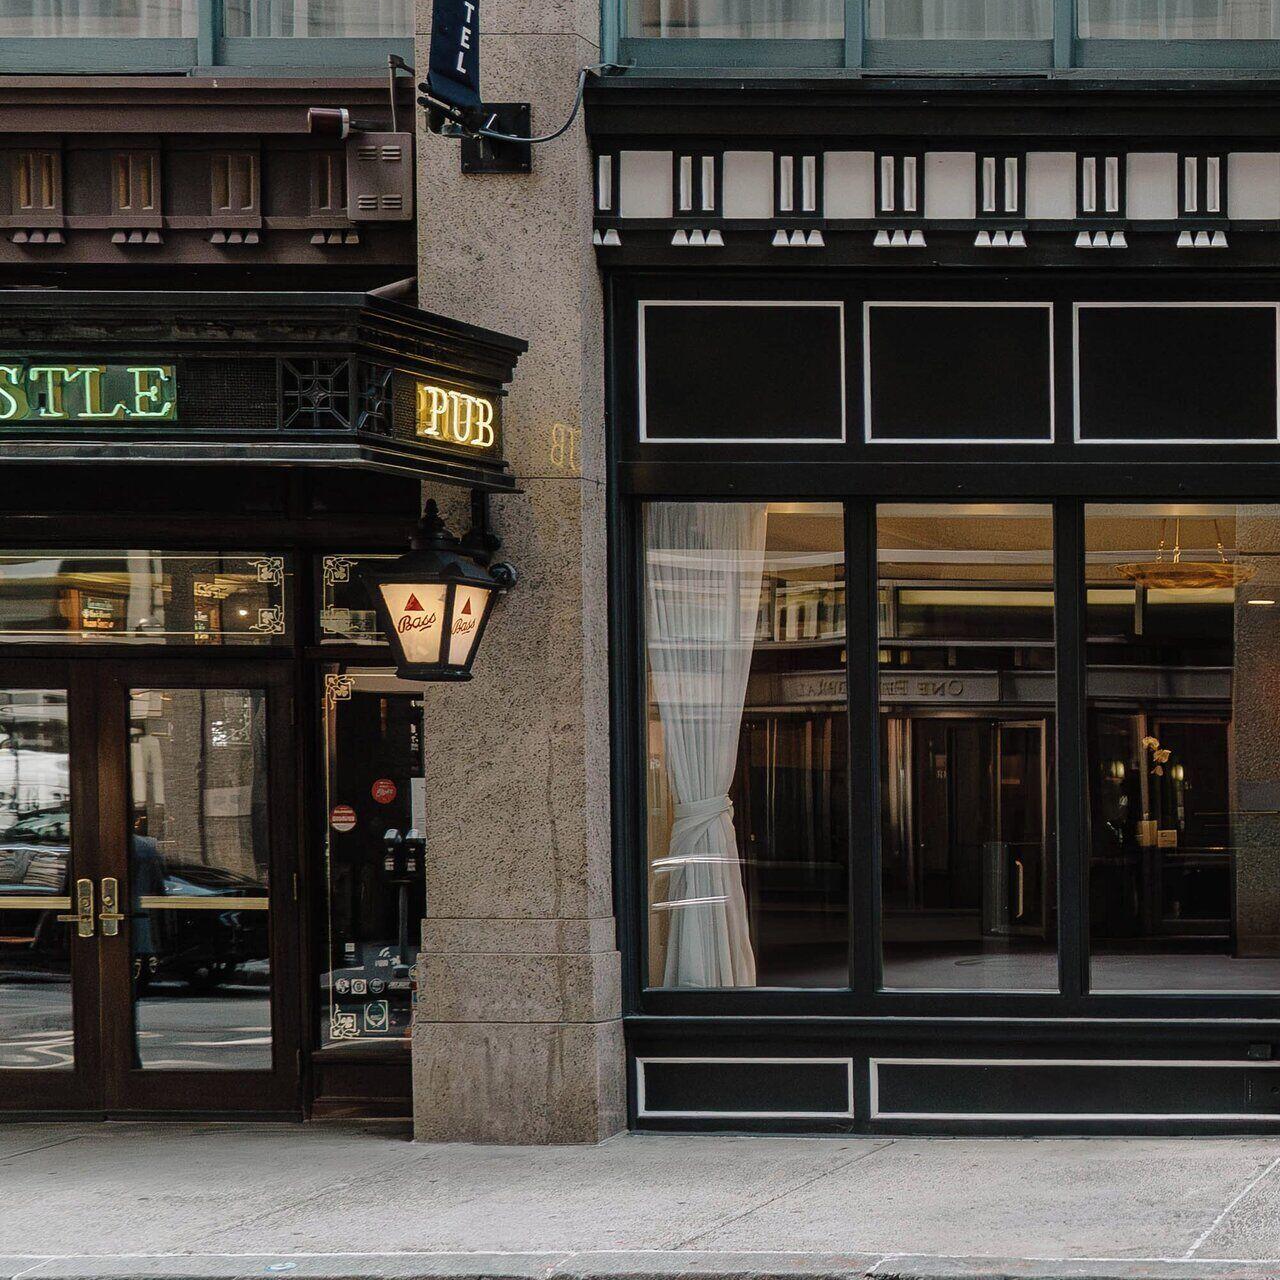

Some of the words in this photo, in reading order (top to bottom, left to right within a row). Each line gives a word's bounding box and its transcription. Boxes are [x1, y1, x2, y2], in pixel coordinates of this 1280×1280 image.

[423, 385, 495, 448] PUB
[398, 613, 437, 634] Bass
[451, 618, 476, 635] Bass
